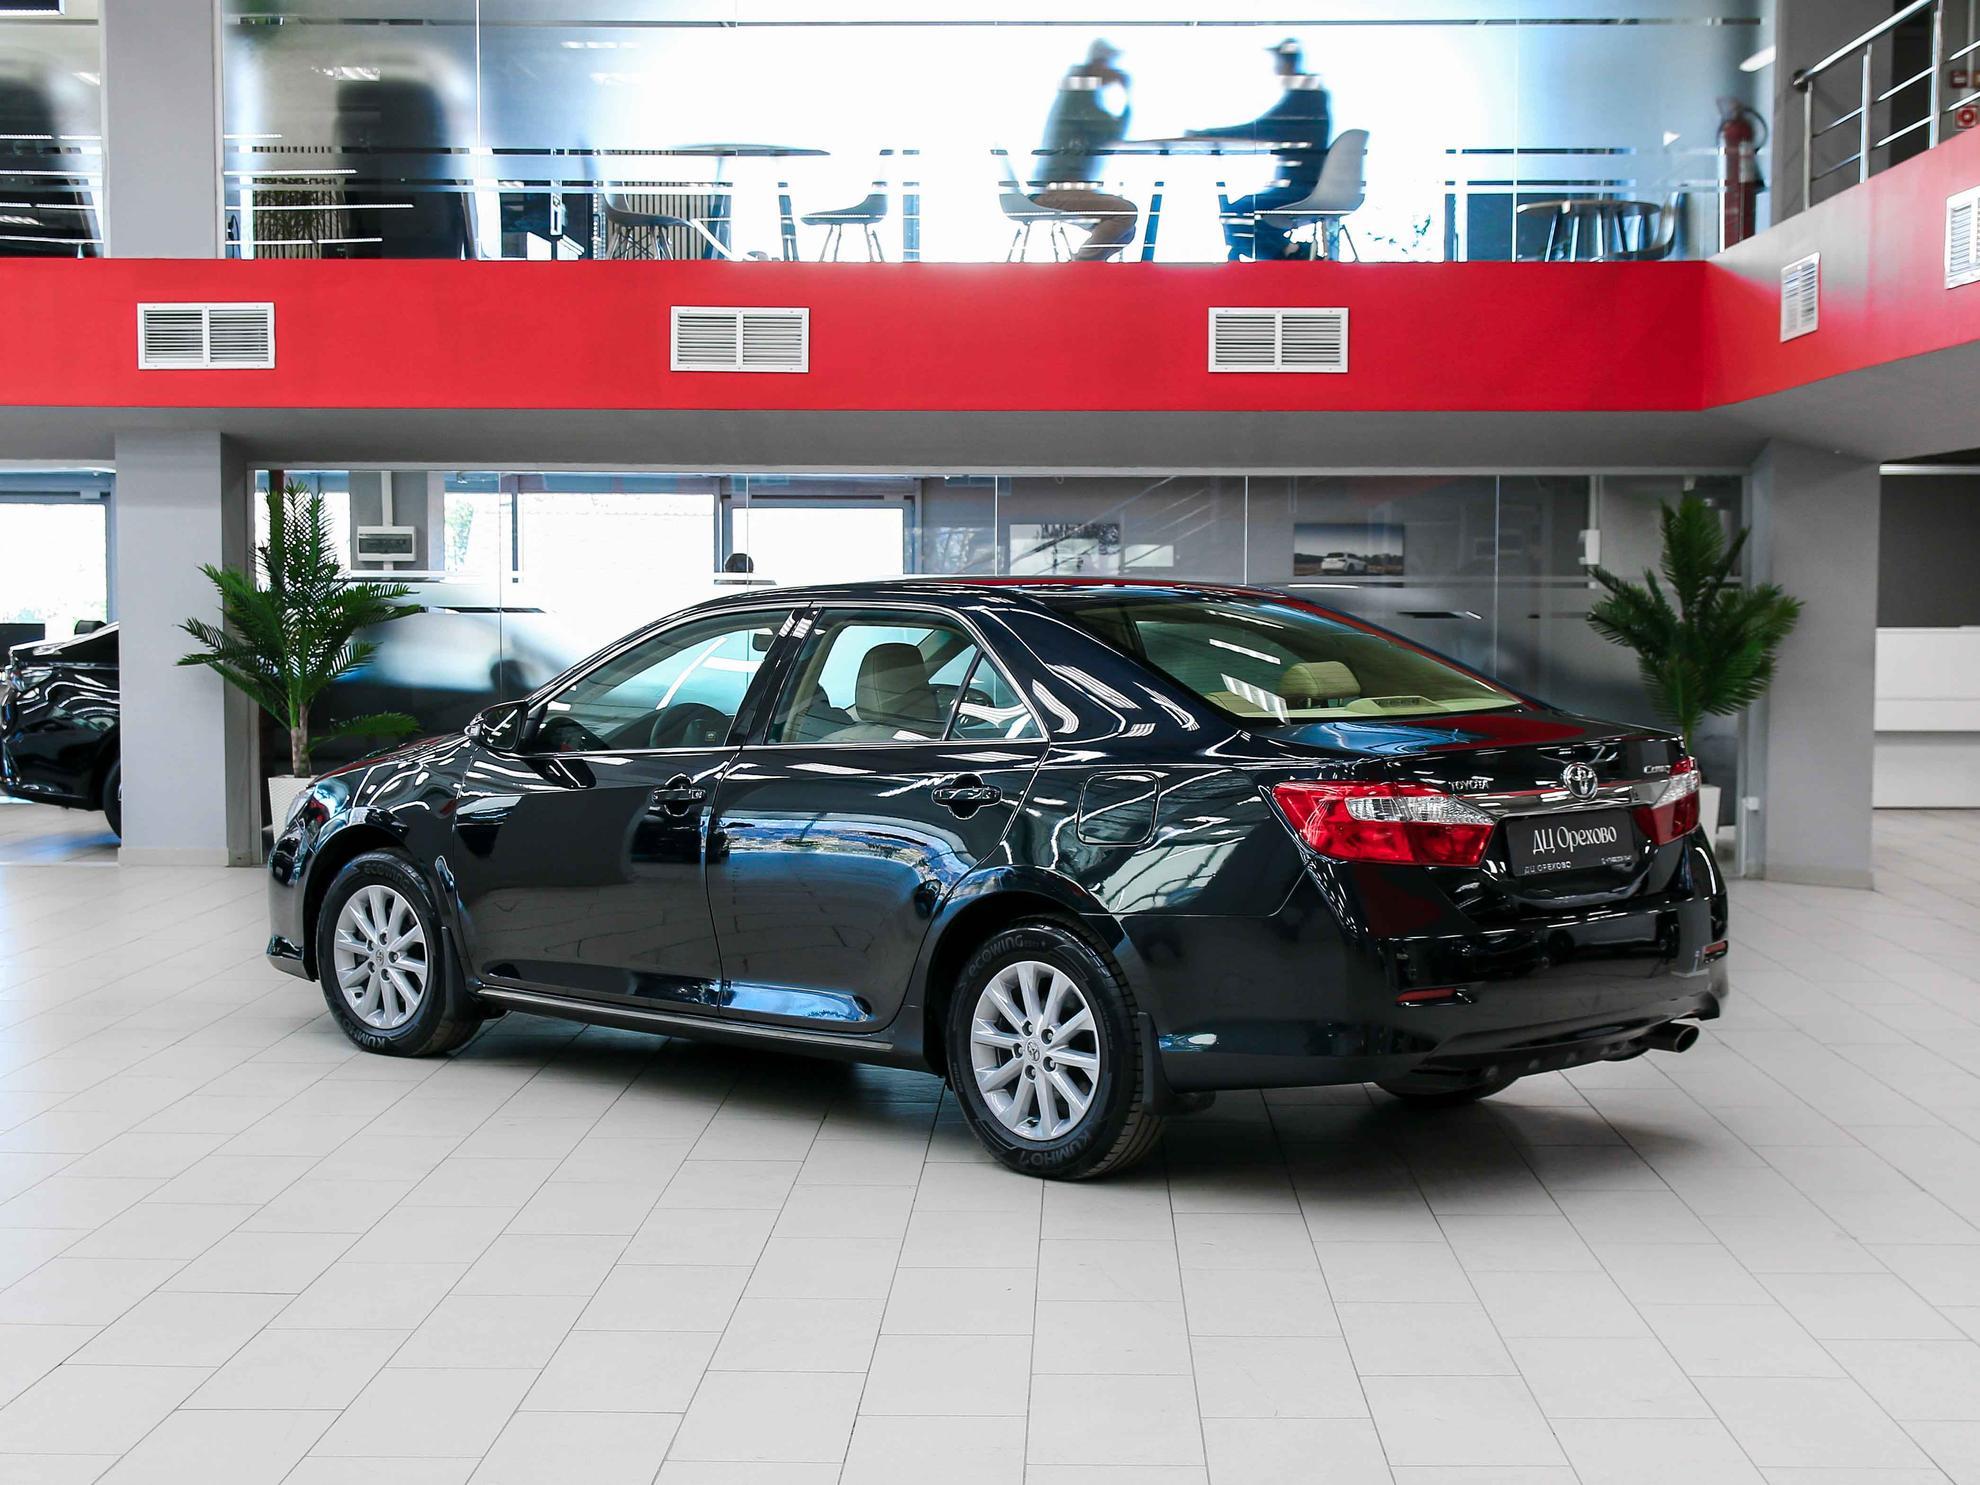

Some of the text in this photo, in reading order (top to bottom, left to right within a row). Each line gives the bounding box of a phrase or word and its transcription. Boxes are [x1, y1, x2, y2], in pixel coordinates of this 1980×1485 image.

[1448, 780, 1489, 791] TOYOTA
[1532, 826, 1617, 855] ДЦ Орехово
